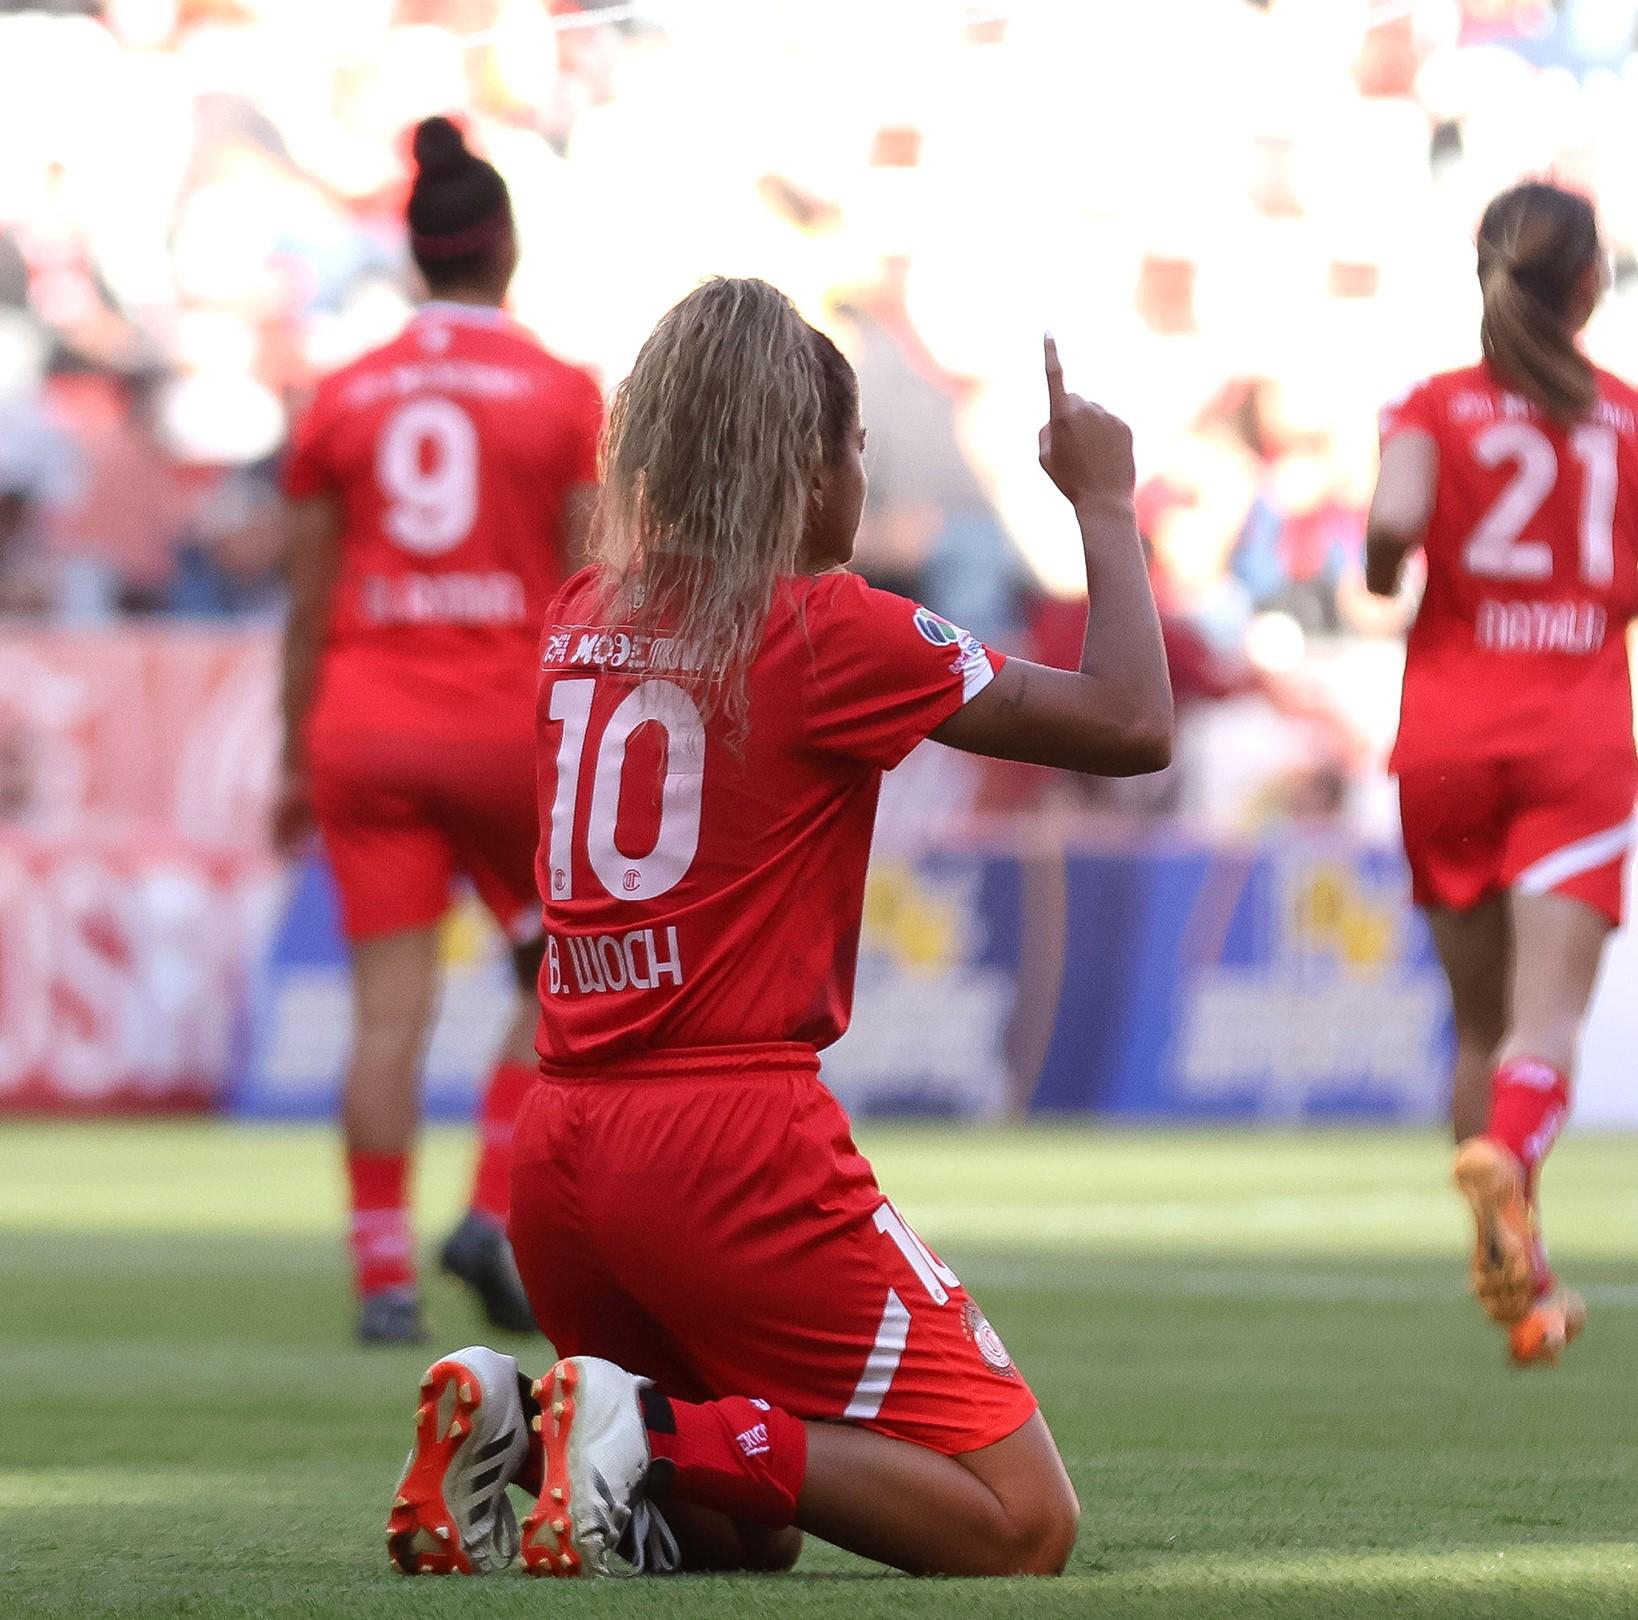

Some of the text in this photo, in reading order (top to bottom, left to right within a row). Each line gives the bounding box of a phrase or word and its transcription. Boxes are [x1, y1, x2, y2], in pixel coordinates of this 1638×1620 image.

[375, 400, 480, 555] 9
[1464, 423, 1618, 587] 21
[549, 678, 706, 901] 10
[547, 925, 683, 994] B. WOCH
